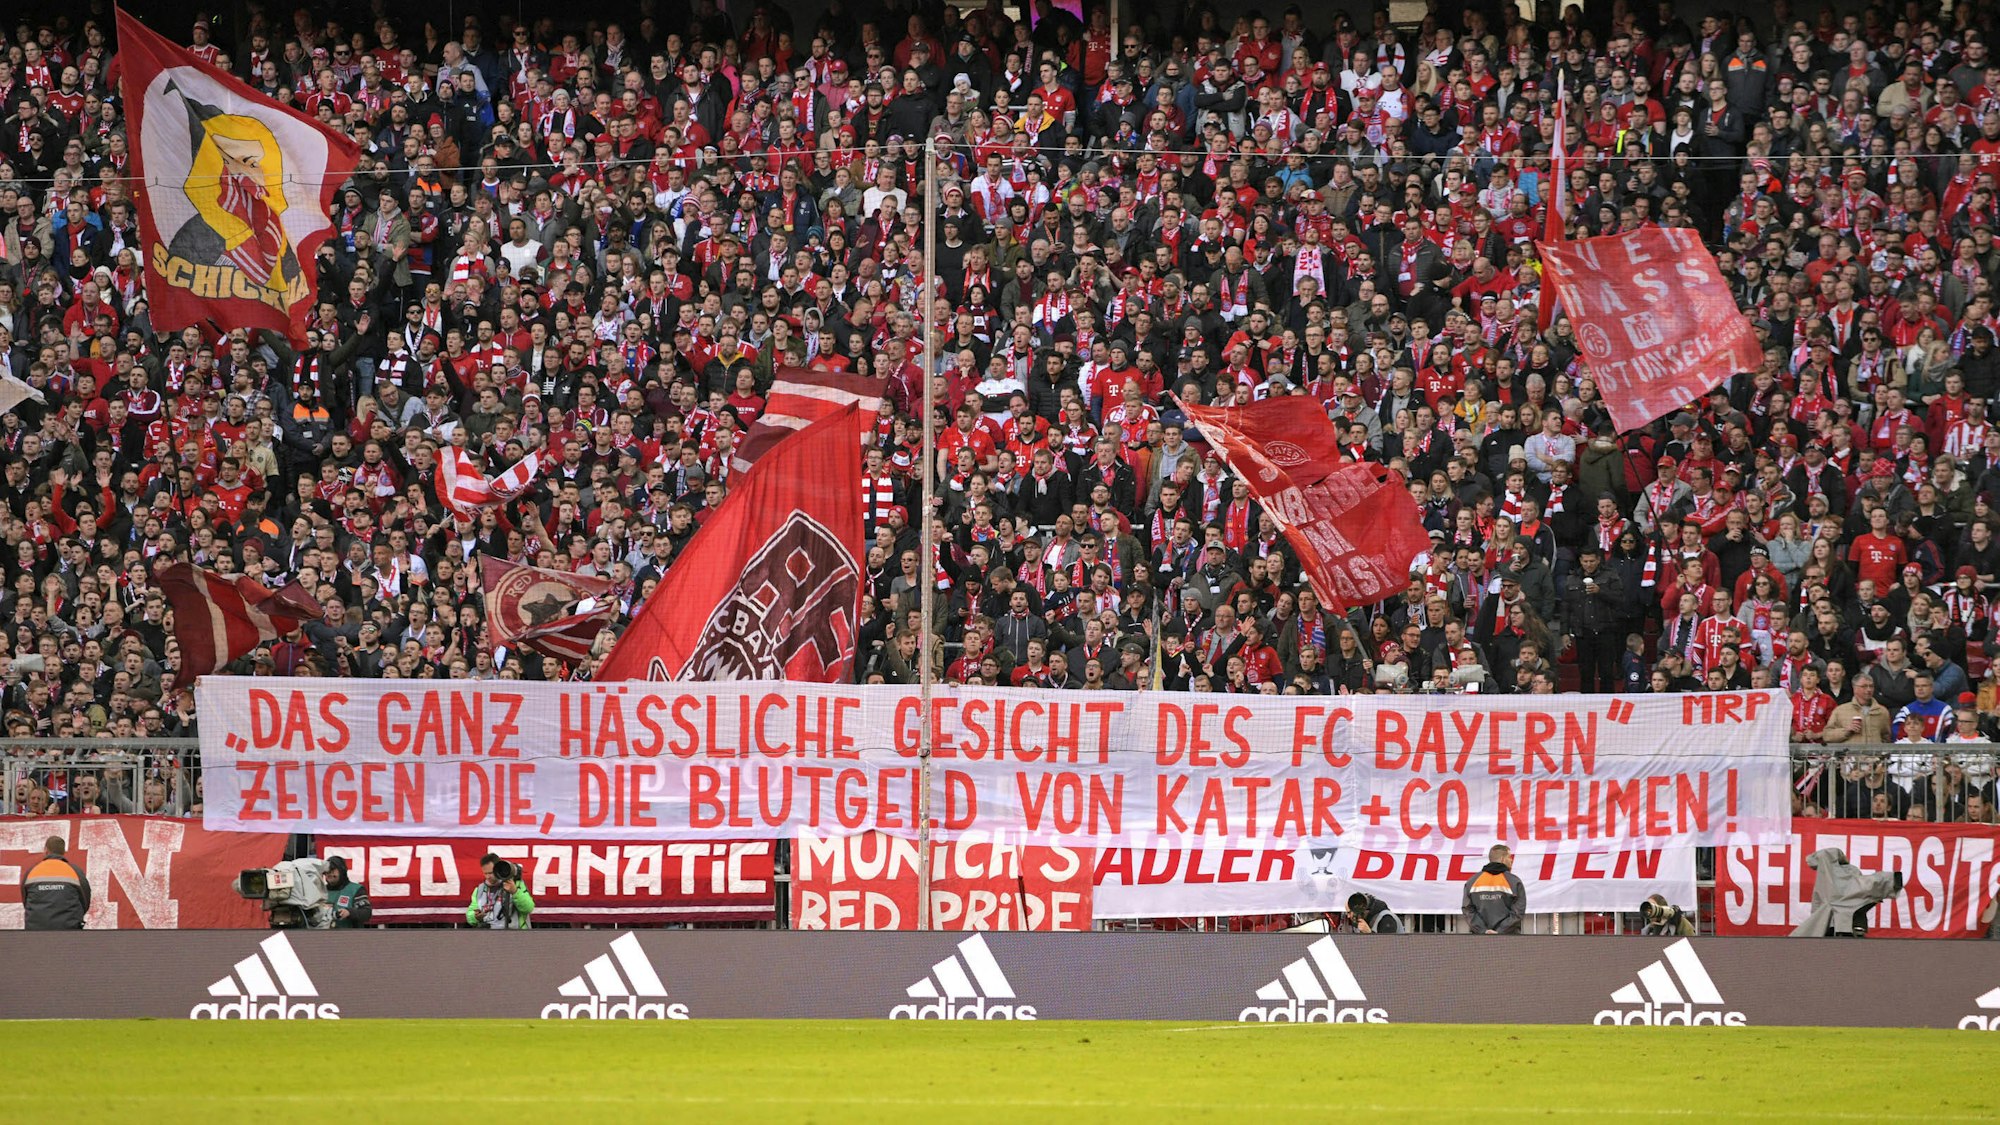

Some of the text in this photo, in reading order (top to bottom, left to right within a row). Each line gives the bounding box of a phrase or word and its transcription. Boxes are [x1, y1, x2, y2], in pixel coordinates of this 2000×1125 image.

[1681, 692, 1771, 725] MRP
[376, 690, 524, 758] GANZ
[559, 685, 861, 761] HÄSSLICHE
[893, 696, 1125, 764] GESICHT
[1155, 702, 1254, 769] DES
[1291, 705, 1355, 768] FC
[235, 760, 425, 822] ZEIGEN
[458, 761, 556, 835] DIE,
[578, 762, 657, 828] DIE
[688, 764, 978, 831] BLUTGELD
[1015, 771, 1124, 835] VON
[1155, 773, 1345, 839] KATAR
[799, 890, 901, 930] RED
[190, 995, 341, 1020] adidas
[540, 995, 690, 1020] adidas
[889, 996, 1038, 1020] adidas
[1238, 999, 1389, 1024] adidas
[1593, 1002, 1748, 1027] adidas
